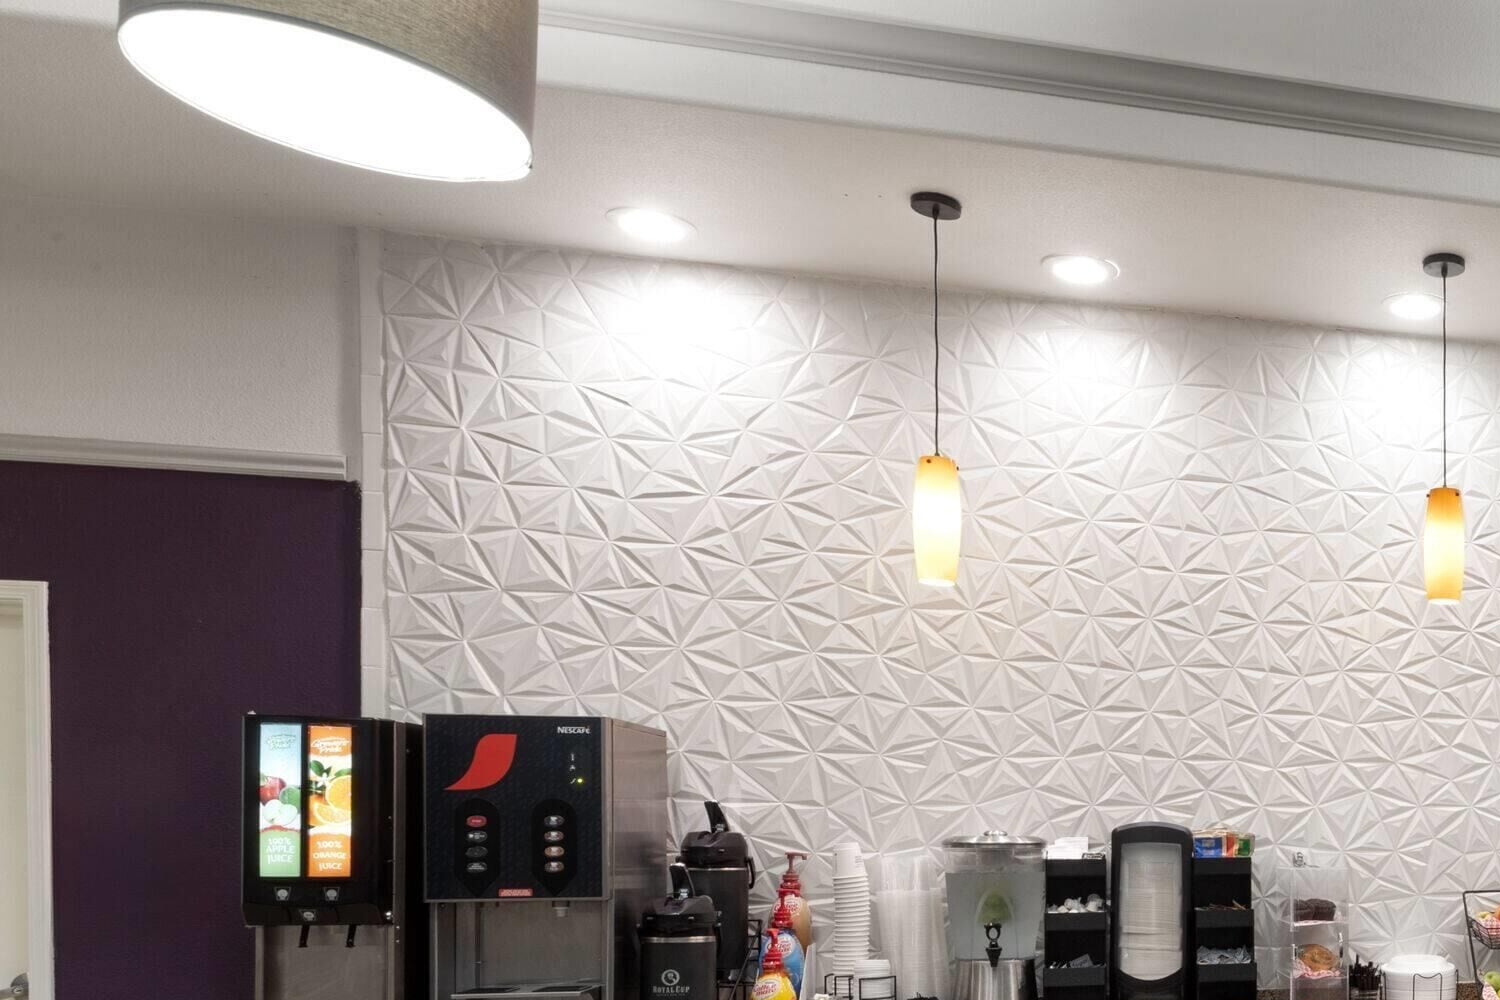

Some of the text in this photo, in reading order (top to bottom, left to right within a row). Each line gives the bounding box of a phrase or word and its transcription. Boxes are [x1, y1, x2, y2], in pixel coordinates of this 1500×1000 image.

[268, 837, 292, 846] 100%
[316, 841, 343, 849] 100%
[266, 845, 296, 854] APPLE
[267, 854, 294, 865] JUICE
[313, 851, 347, 860] ORANGE
[319, 862, 343, 872] JUICE
[652, 985, 690, 993] ROYAL CUP
